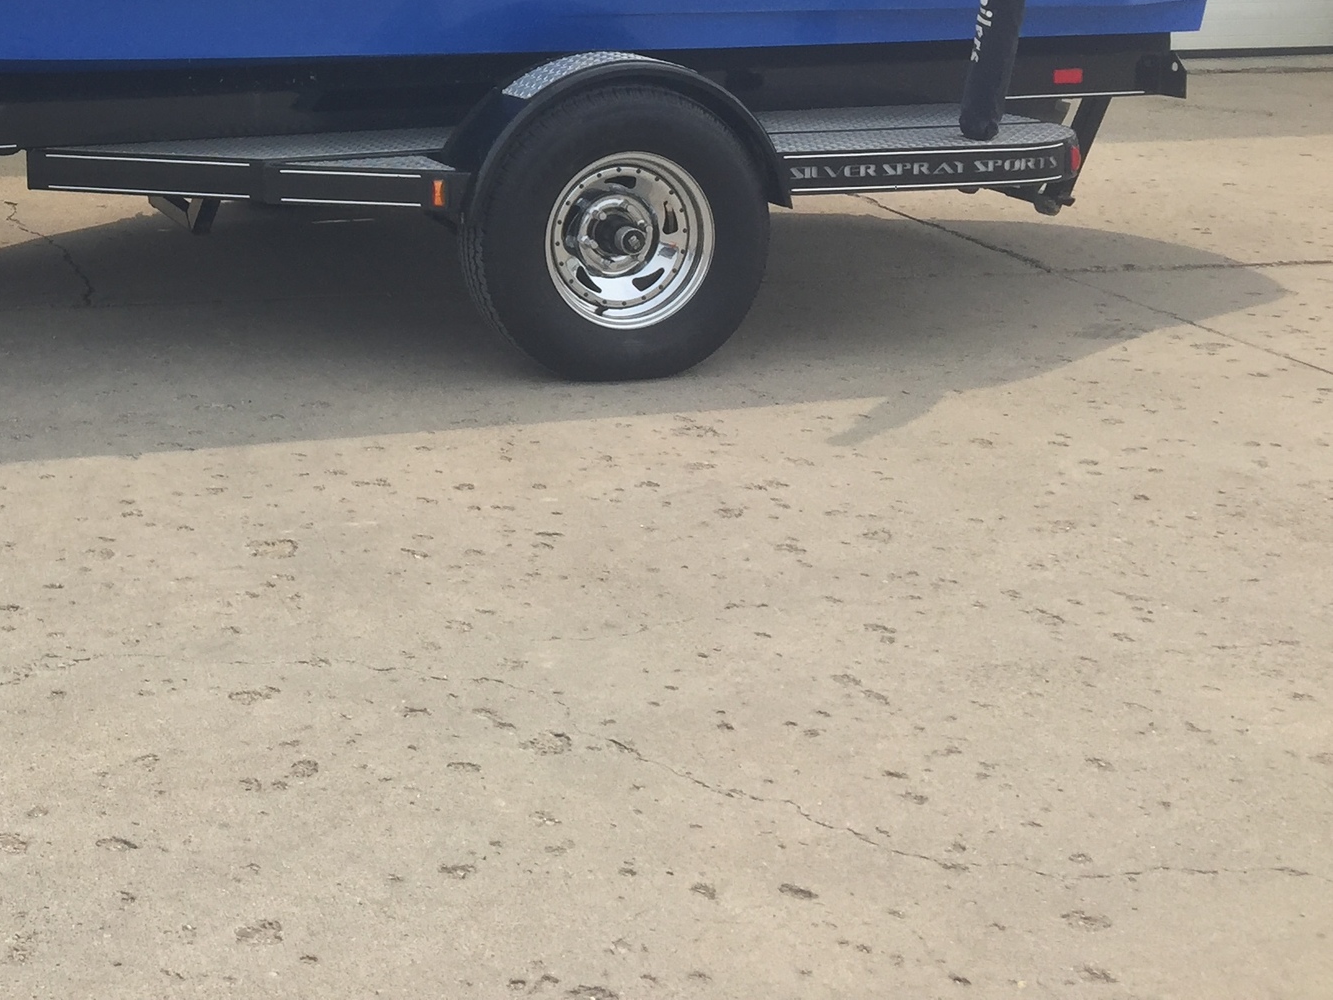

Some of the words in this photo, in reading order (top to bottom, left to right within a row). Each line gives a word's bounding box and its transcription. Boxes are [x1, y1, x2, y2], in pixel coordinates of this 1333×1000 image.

[790, 164, 876, 180] SILVER
[882, 160, 964, 176] SPRAY
[974, 156, 1058, 172] SPORTS
